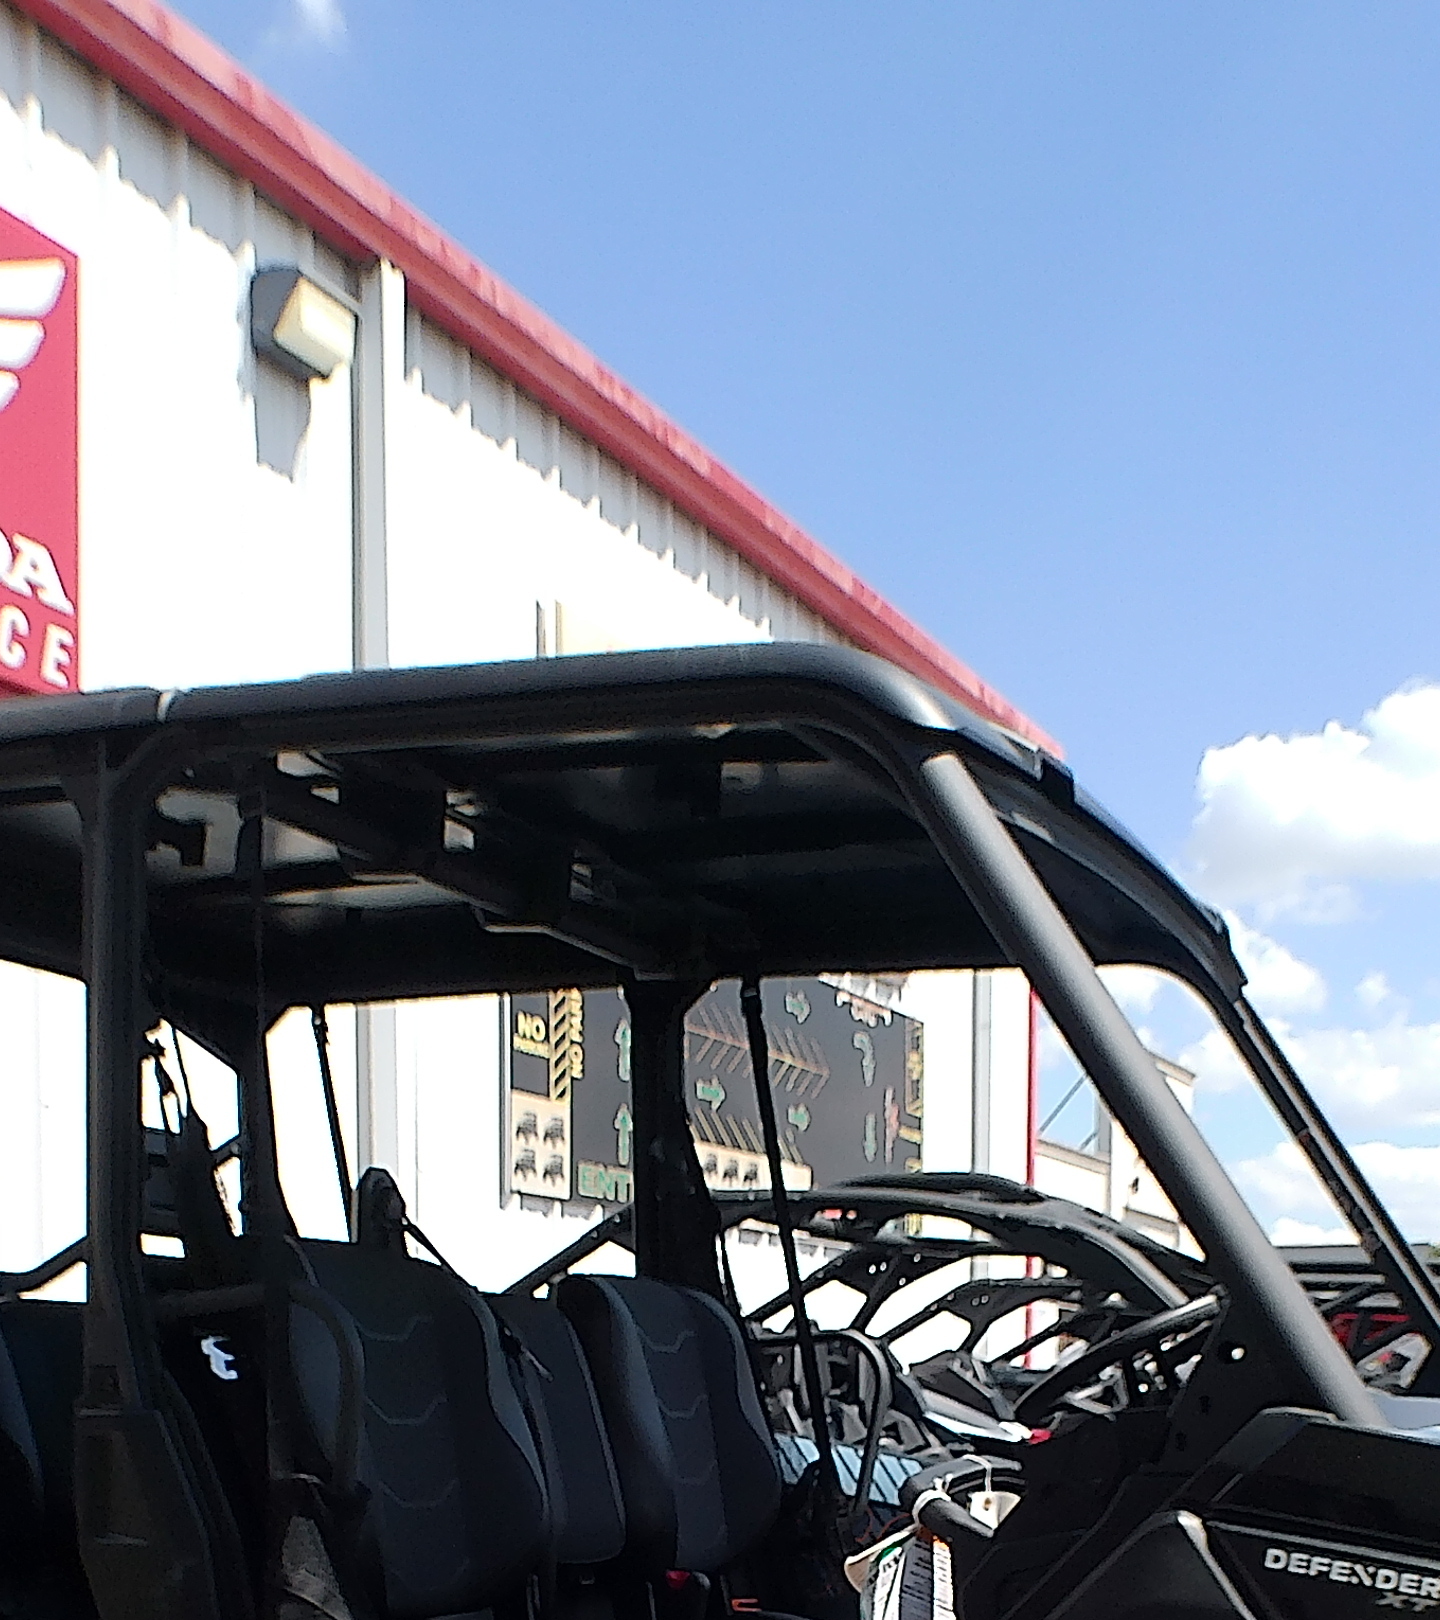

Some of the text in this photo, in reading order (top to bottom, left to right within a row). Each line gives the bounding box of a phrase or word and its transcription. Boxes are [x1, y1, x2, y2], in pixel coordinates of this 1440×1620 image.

[517, 1010, 546, 1042] NO
[578, 1160, 635, 1203] ENT
[1375, 1592, 1440, 1612] XT
